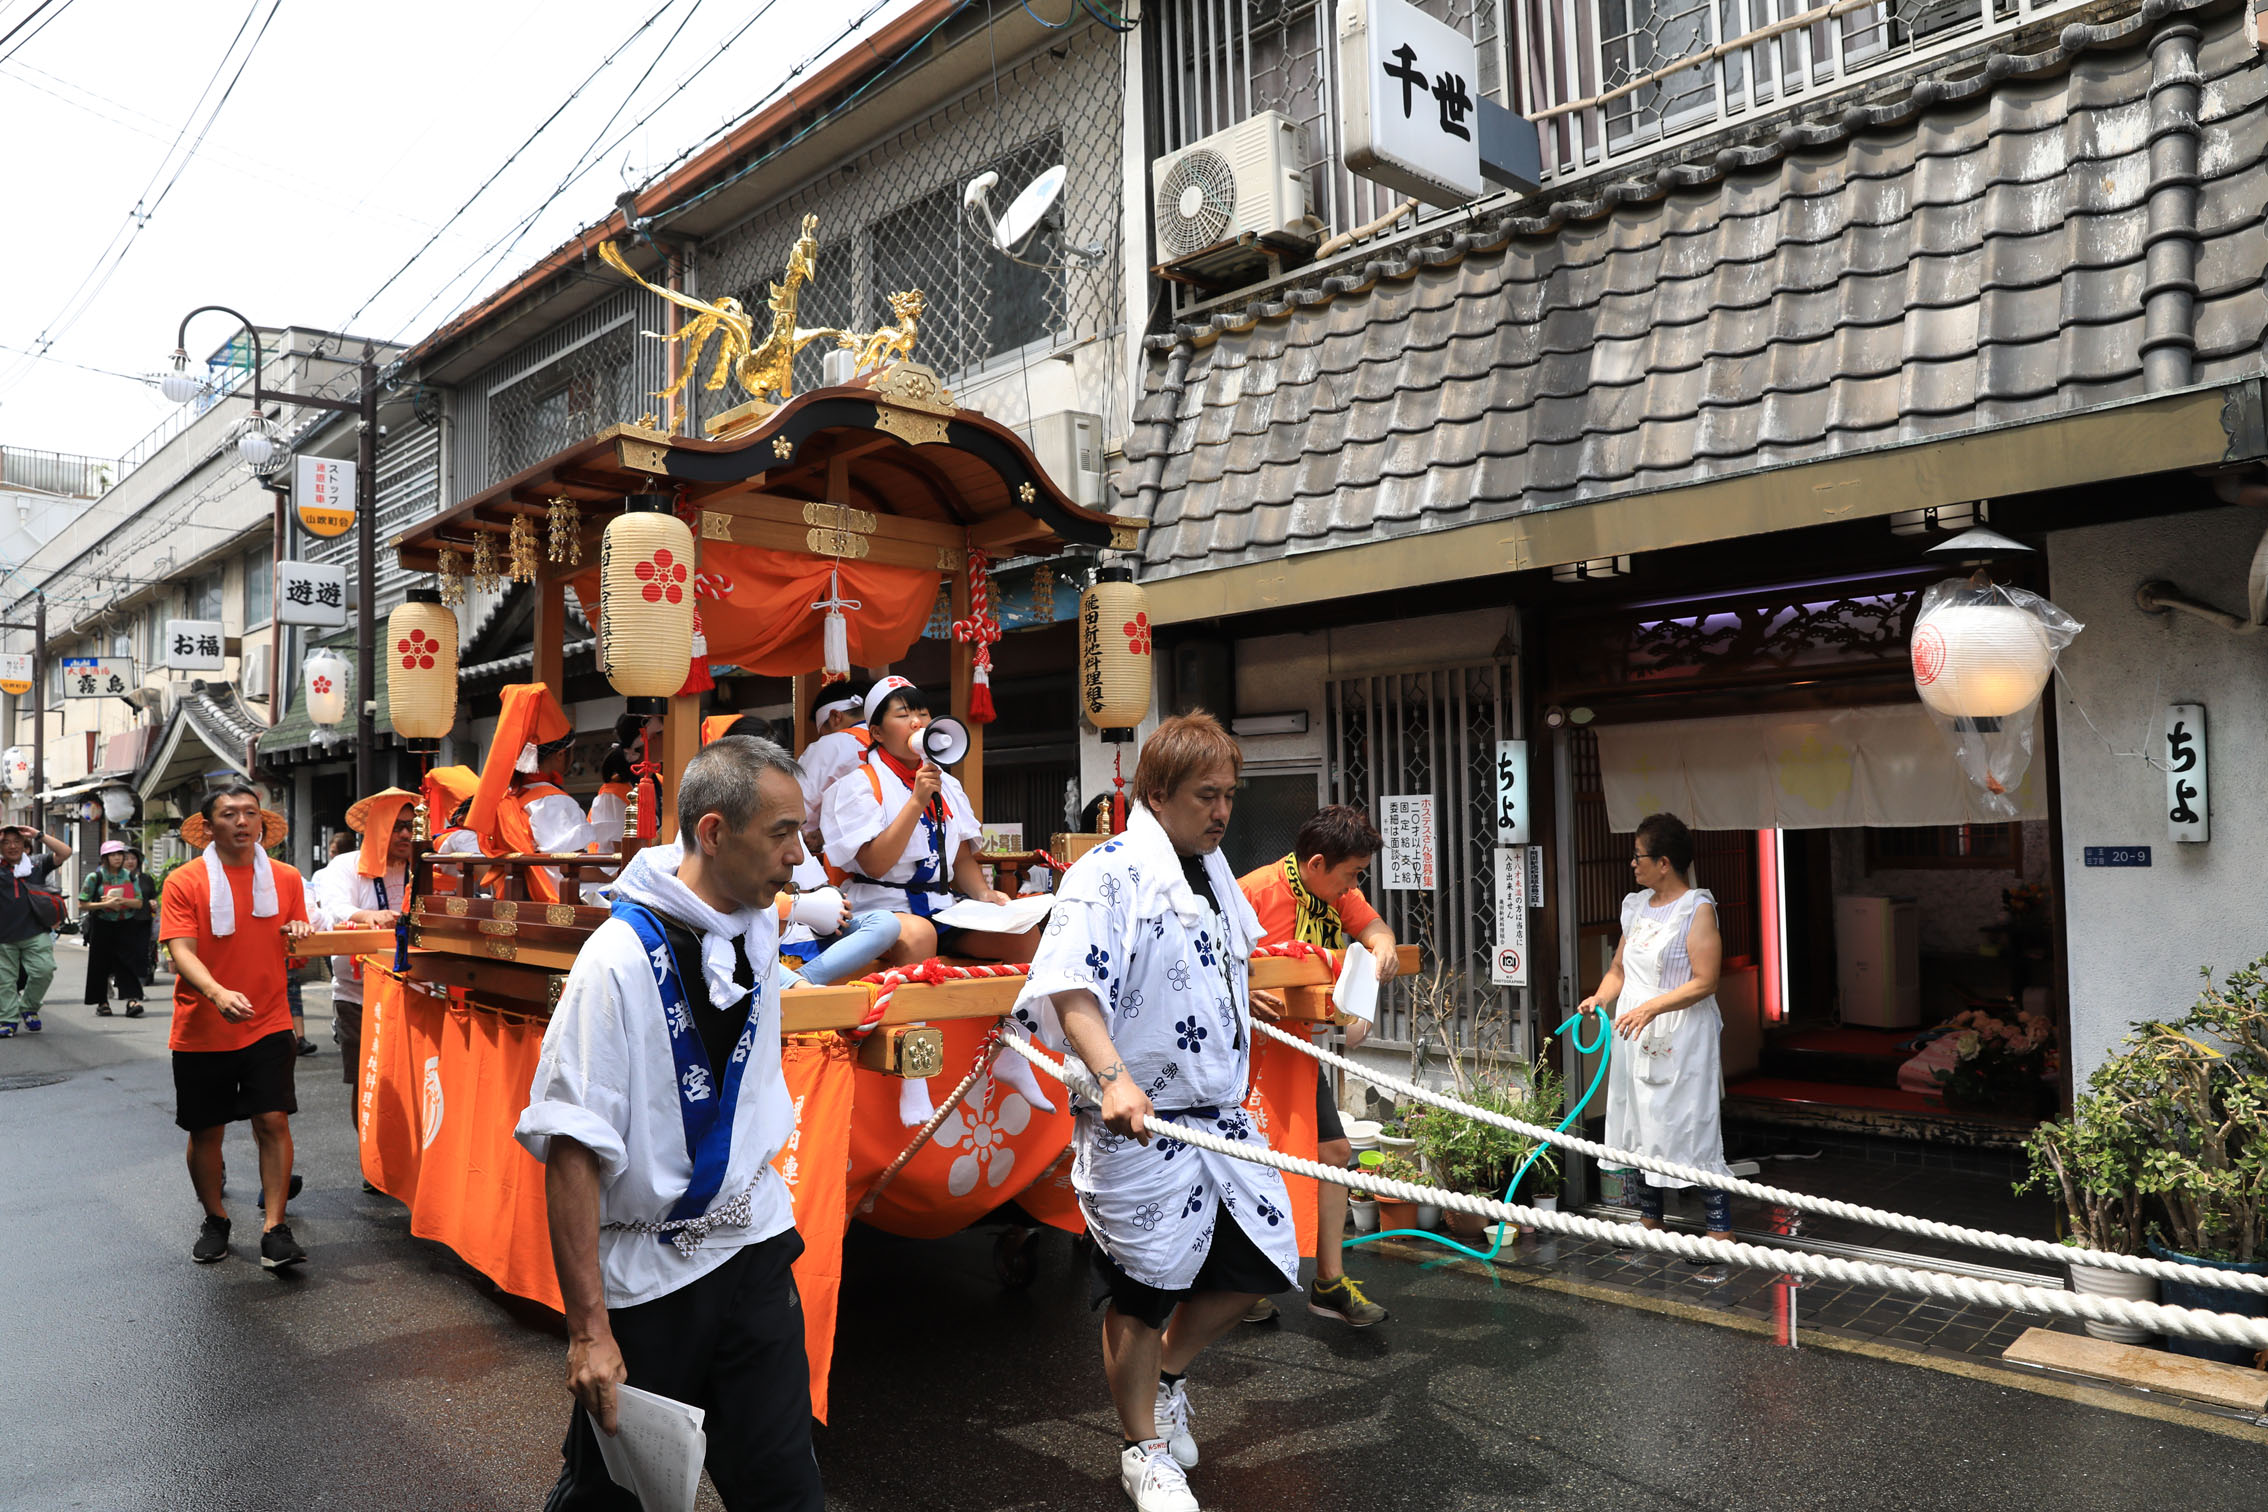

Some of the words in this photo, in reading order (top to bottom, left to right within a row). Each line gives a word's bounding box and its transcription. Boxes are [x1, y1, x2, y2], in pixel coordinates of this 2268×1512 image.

[1382, 42, 1473, 142] 千世
[306, 514, 349, 528] 山吹町会
[328, 464, 339, 505] ストップ
[286, 579, 343, 608] 遊遊
[77, 674, 125, 694] 霧島
[174, 633, 220, 657] お福
[1084, 593, 1107, 714] 飛田新地料理組合
[1497, 751, 1515, 829] ちよ
[2167, 721, 2199, 824] ちよ
[1389, 802, 1400, 884] 委細は面談の上
[1400, 802, 1411, 884] 固定給支給
[1420, 799, 1433, 888] ホステスさん急募集
[2112, 851, 2146, 862] 20-9
[1504, 853, 1514, 920] 入店出来ません
[1514, 853, 1523, 947] 十八才未満の方は当店に
[649, 943, 711, 1103] 天満宮
